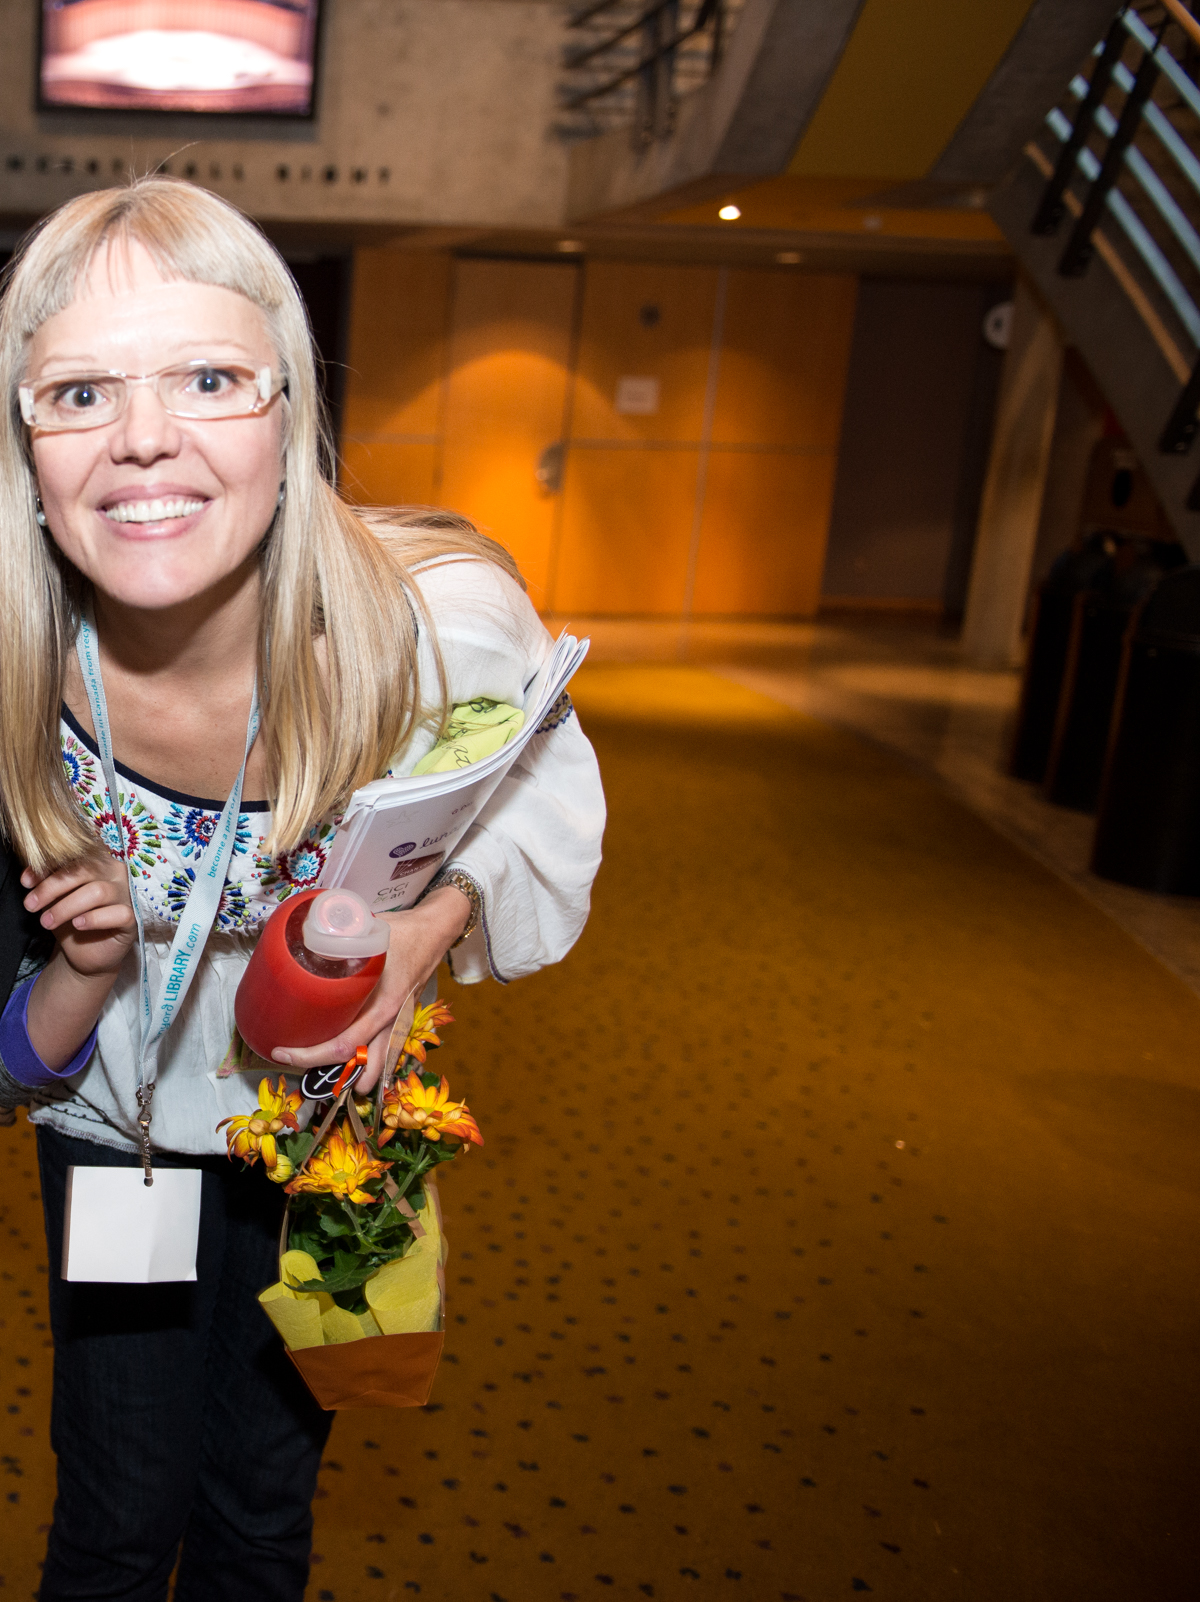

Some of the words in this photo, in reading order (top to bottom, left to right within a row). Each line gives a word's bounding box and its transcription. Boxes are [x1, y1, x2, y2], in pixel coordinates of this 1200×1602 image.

[85, 651, 94, 676] from
[208, 841, 226, 878] become
[224, 810, 234, 834] part
